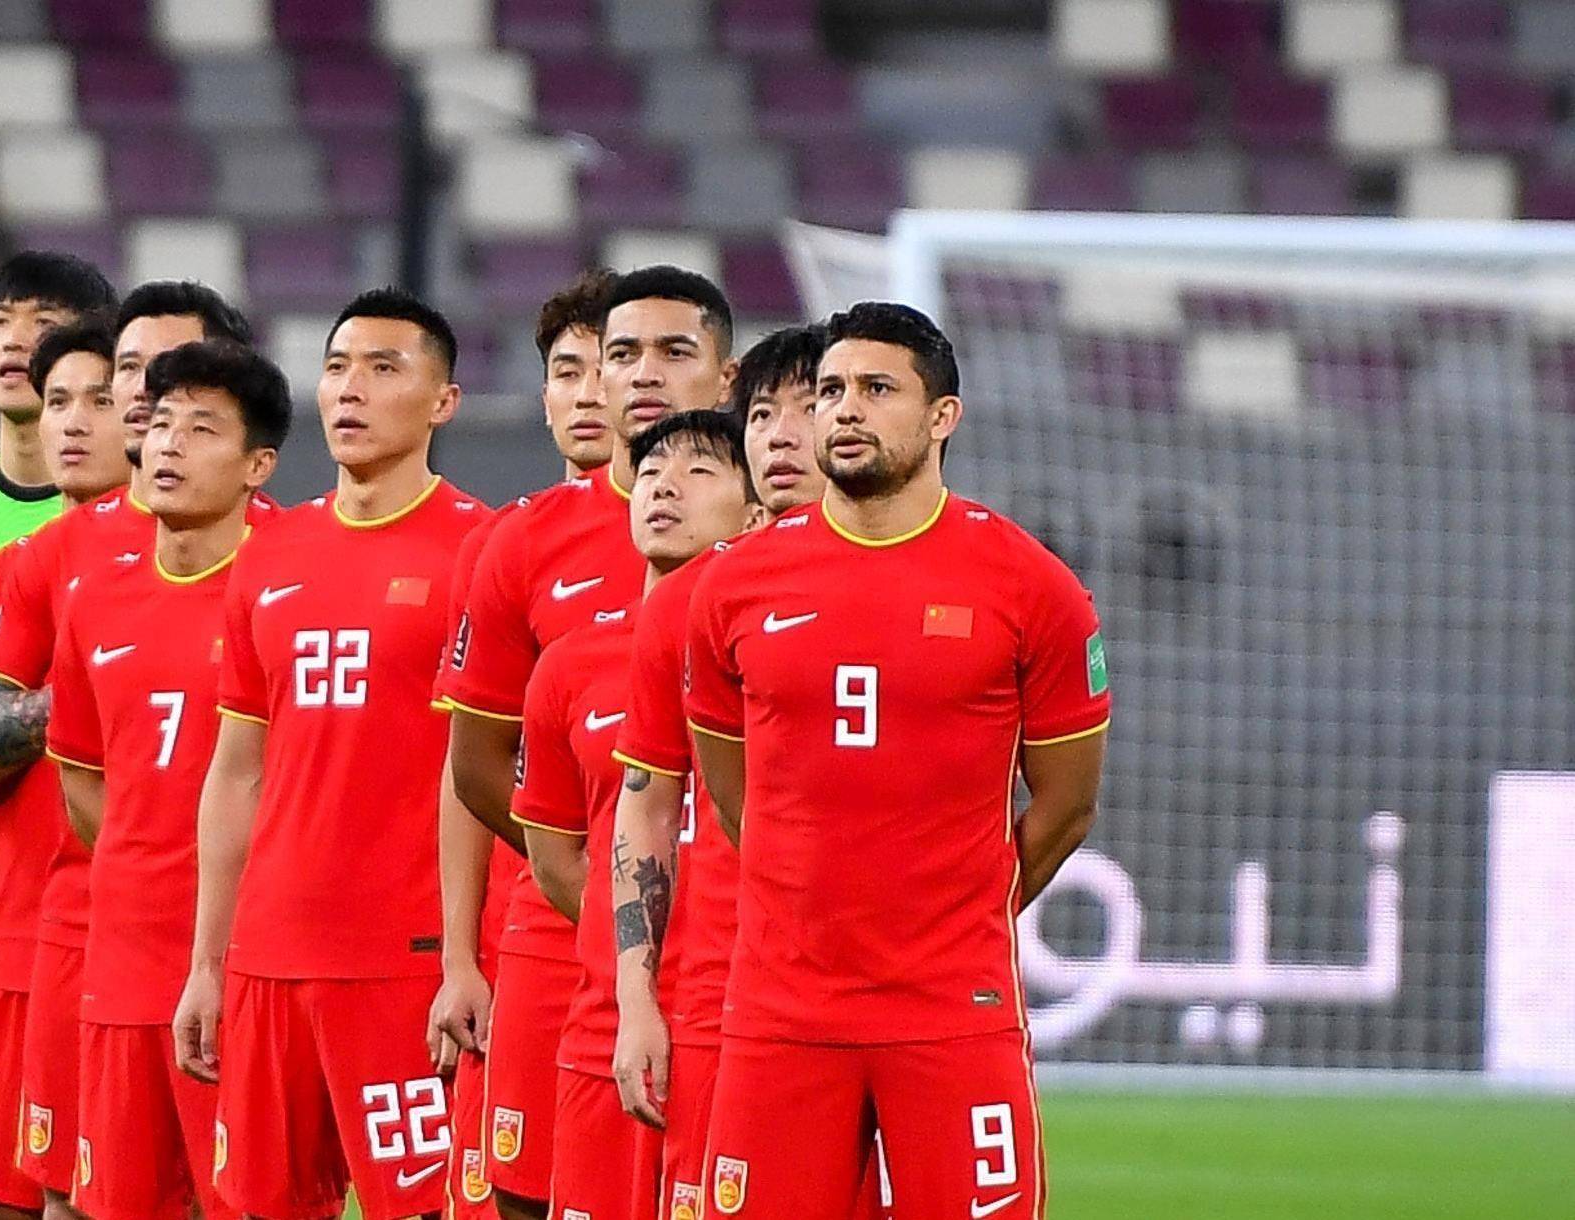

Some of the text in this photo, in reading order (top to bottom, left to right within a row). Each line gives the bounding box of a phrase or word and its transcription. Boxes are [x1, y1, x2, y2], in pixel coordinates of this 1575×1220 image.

[295, 629, 370, 706] 22
[835, 665, 878, 747] 9
[149, 691, 186, 768] 7
[362, 1076, 452, 1160] 22
[970, 1102, 1017, 1188] 9
